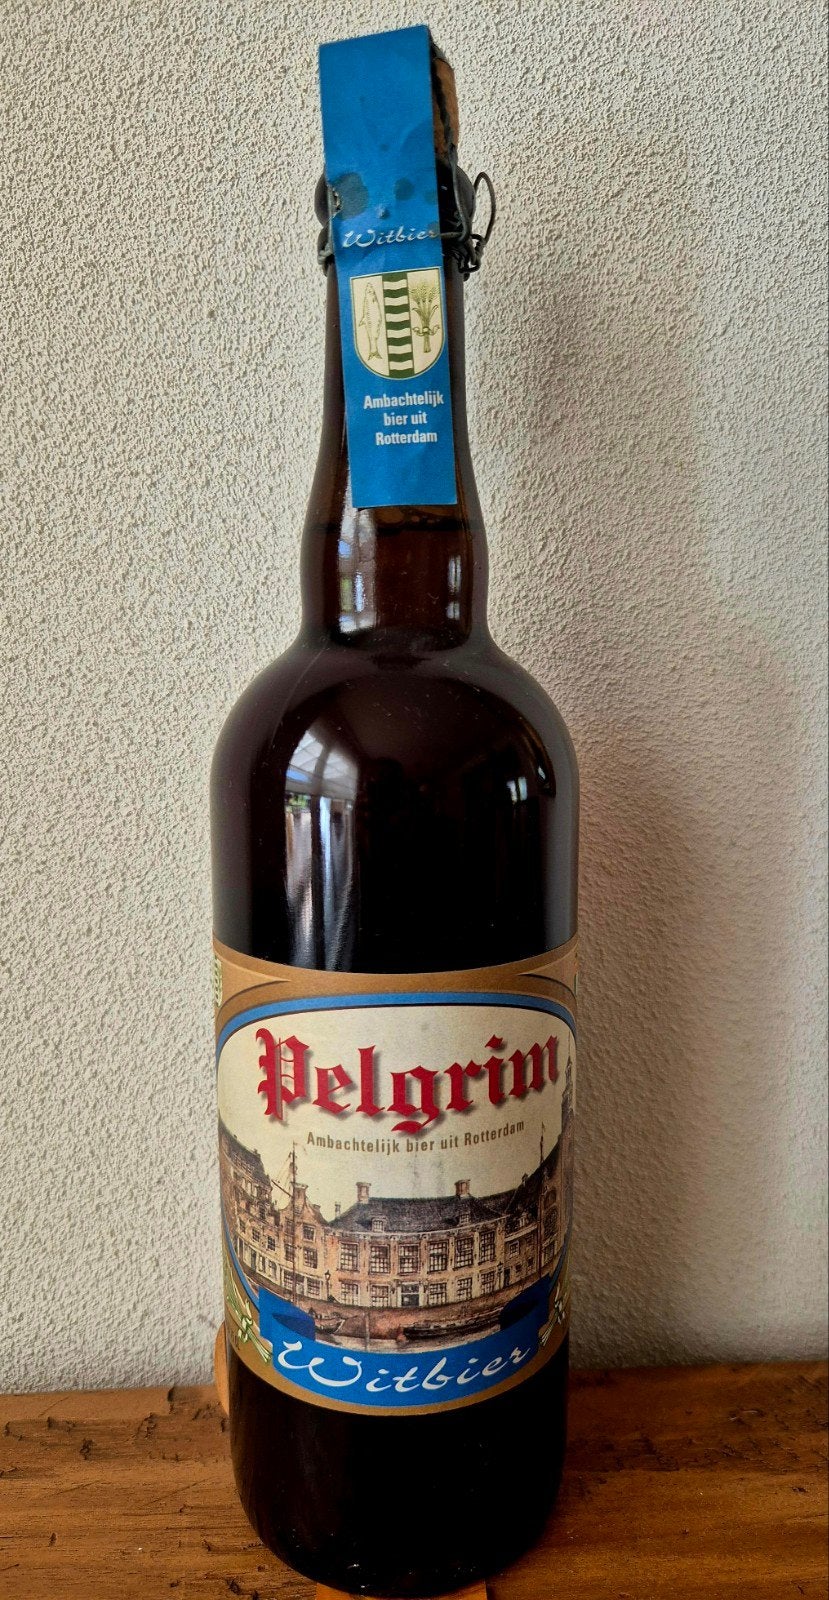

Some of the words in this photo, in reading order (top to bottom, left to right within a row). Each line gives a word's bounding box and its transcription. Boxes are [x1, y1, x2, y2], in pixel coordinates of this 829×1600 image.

[343, 225, 439, 248] Witbier
[364, 391, 443, 409] Ambachtelijk
[383, 412, 408, 426] bier
[411, 411, 427, 424] uit
[375, 430, 437, 446] Rotterdam
[255, 1027, 559, 1134] Pelgrim
[307, 1132, 400, 1155] Ambachtelijk
[406, 1138, 436, 1152] bier
[440, 1135, 460, 1149] uit
[464, 1120, 525, 1146] Rotterdam
[278, 1341, 530, 1392] Witbier
